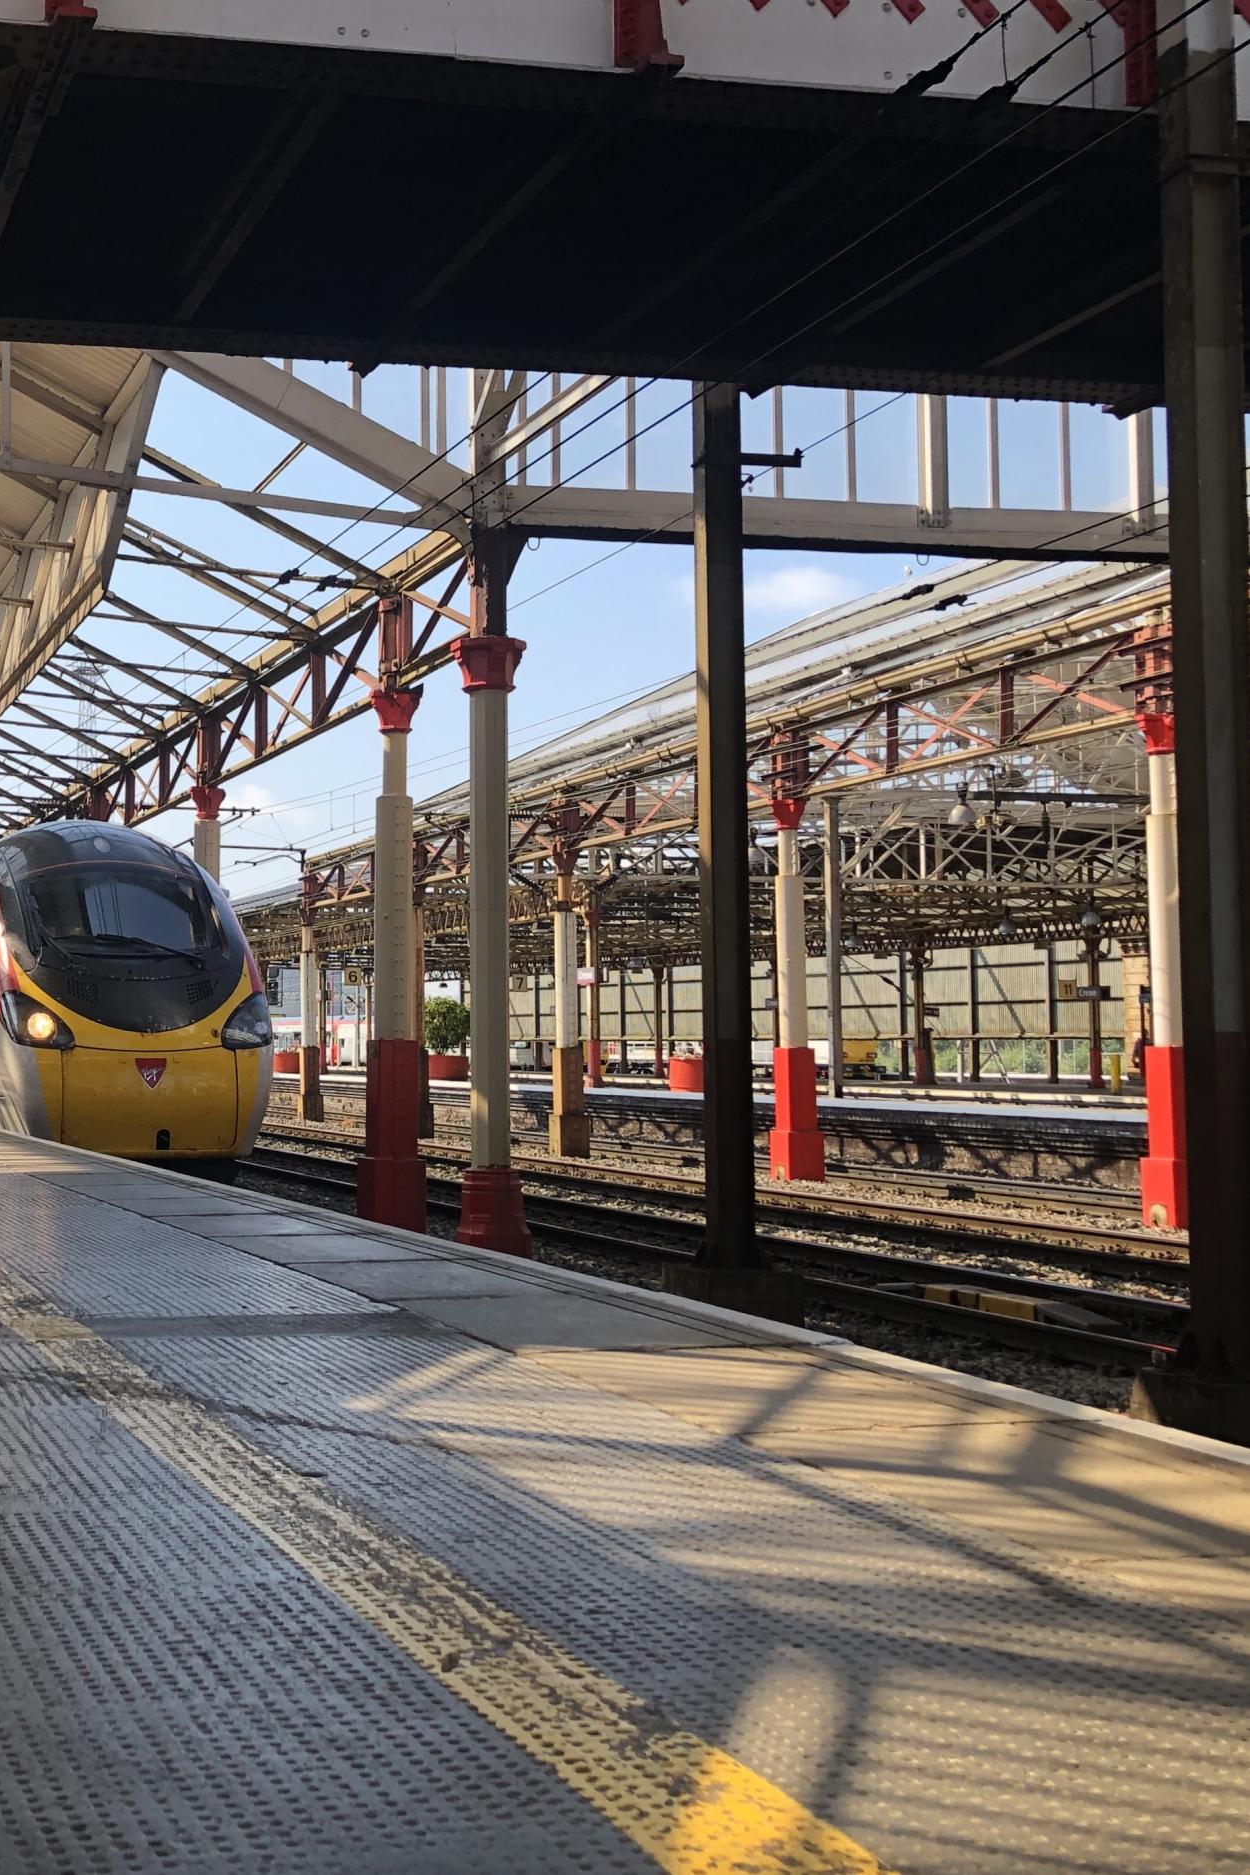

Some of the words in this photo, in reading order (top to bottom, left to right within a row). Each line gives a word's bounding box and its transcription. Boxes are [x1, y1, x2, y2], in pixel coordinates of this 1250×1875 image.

[348, 970, 358, 983] 6
[516, 977, 524, 990] 7
[1063, 983, 1073, 996] 11
